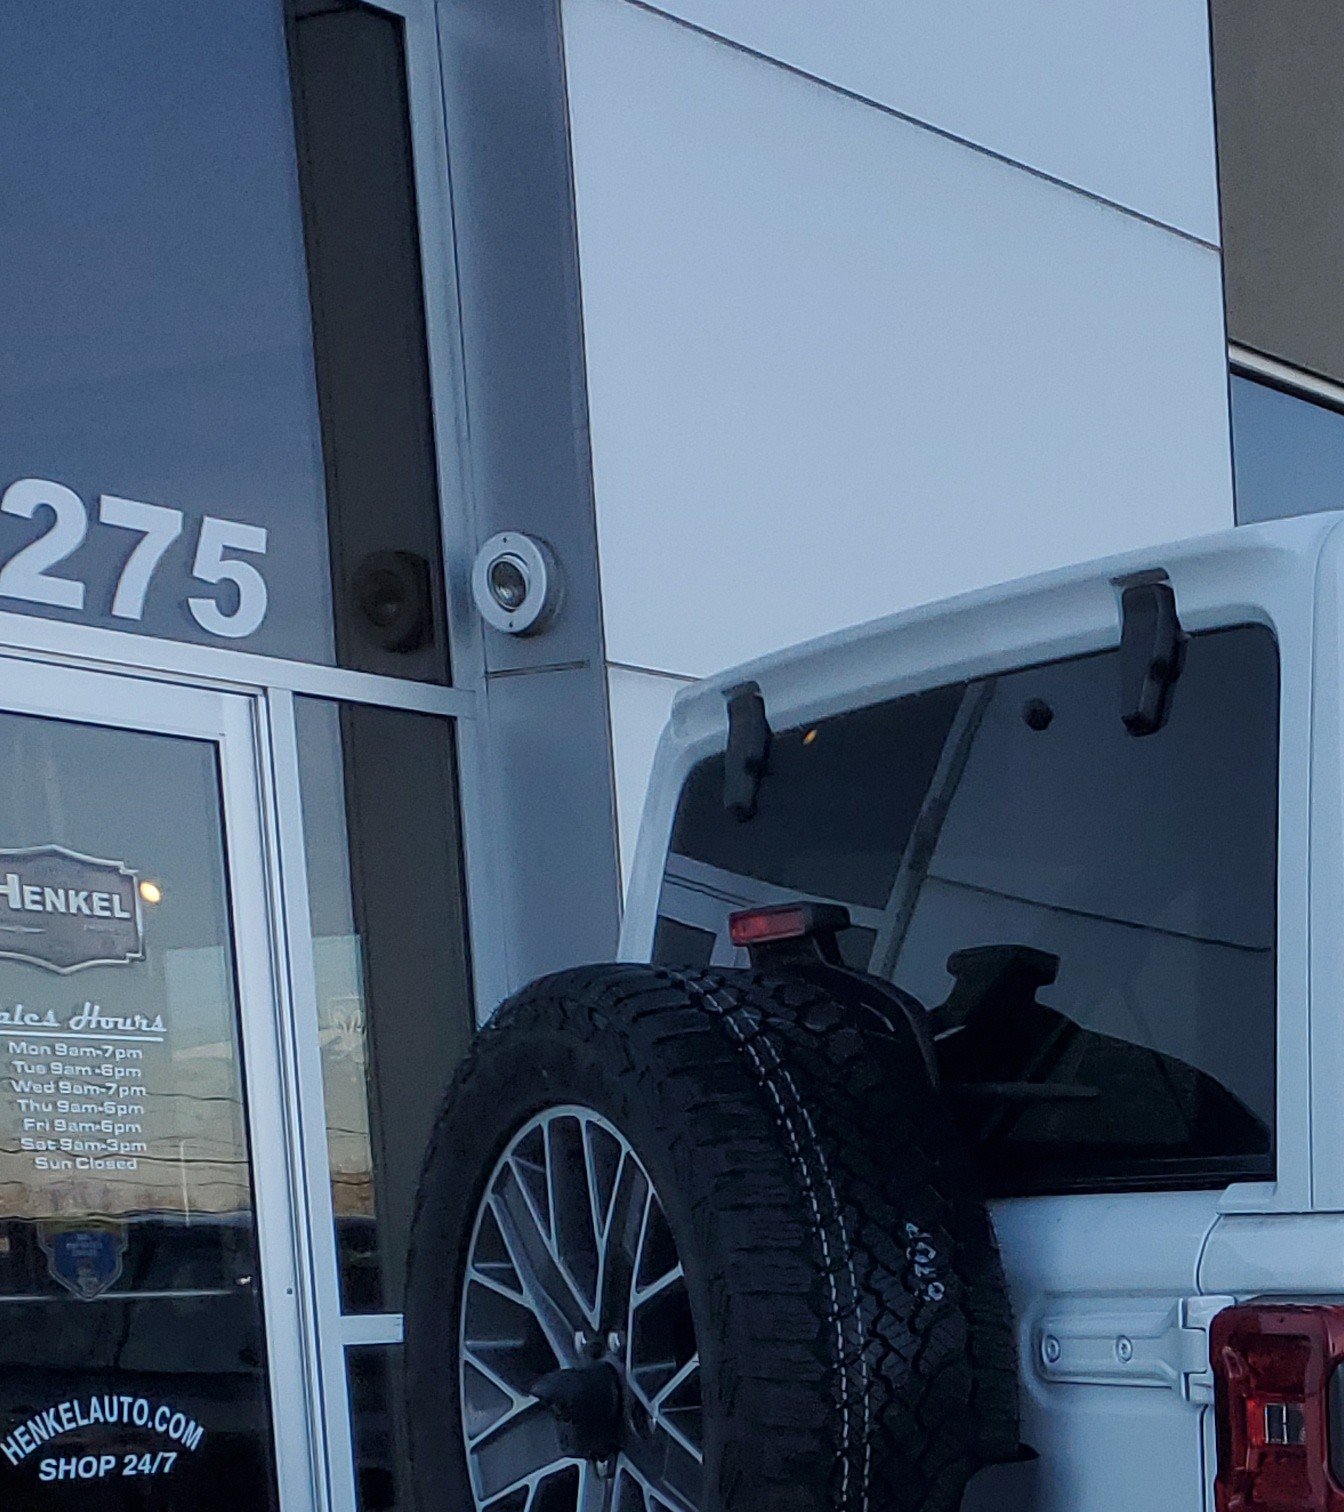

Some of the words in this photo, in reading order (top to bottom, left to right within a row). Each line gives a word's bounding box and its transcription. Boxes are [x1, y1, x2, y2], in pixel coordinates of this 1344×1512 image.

[0, 478, 268, 639] 275
[0, 1003, 61, 1027] ales
[69, 1001, 167, 1032] Hours
[8, 1041, 51, 1056] Mon
[55, 1043, 143, 1061] 9am-7pm
[12, 1060, 47, 1074] Tue
[11, 1080, 55, 1094] Wed
[59, 1081, 147, 1098] 9am-7pm
[17, 1099, 52, 1112] Thu
[23, 1118, 50, 1131] Fri
[20, 1138, 58, 1151] Sat
[34, 1157, 72, 1170] Sun
[76, 1157, 137, 1170] Closed
[0, 1395, 204, 1466] HENKELAUTO.COM
[38, 1455, 116, 1481] SHOP
[122, 1451, 178, 1476] 24/7
